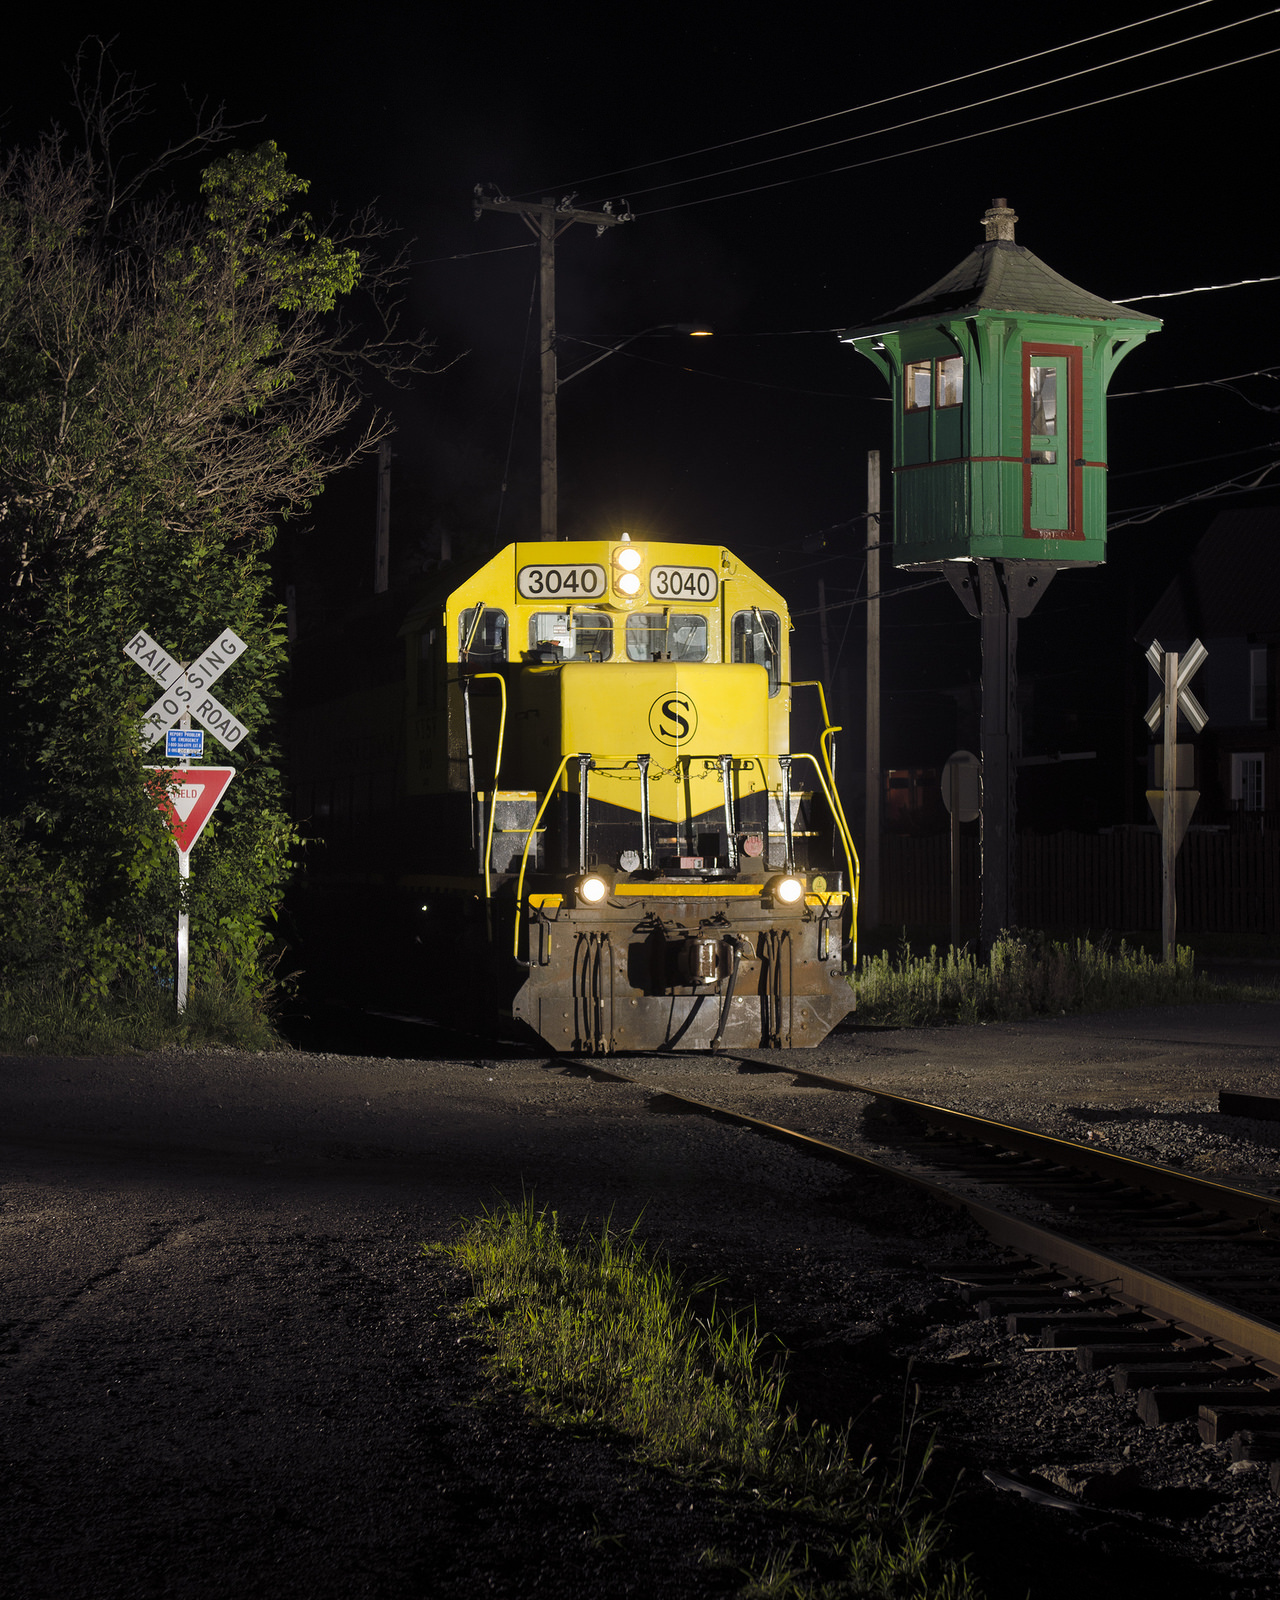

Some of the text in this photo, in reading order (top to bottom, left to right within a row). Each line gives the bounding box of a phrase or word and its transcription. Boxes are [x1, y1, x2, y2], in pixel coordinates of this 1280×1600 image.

[528, 569, 598, 594] 3040
[656, 571, 710, 597] 3040
[128, 635, 241, 743] RAIL ROAD
[659, 699, 690, 739] S
